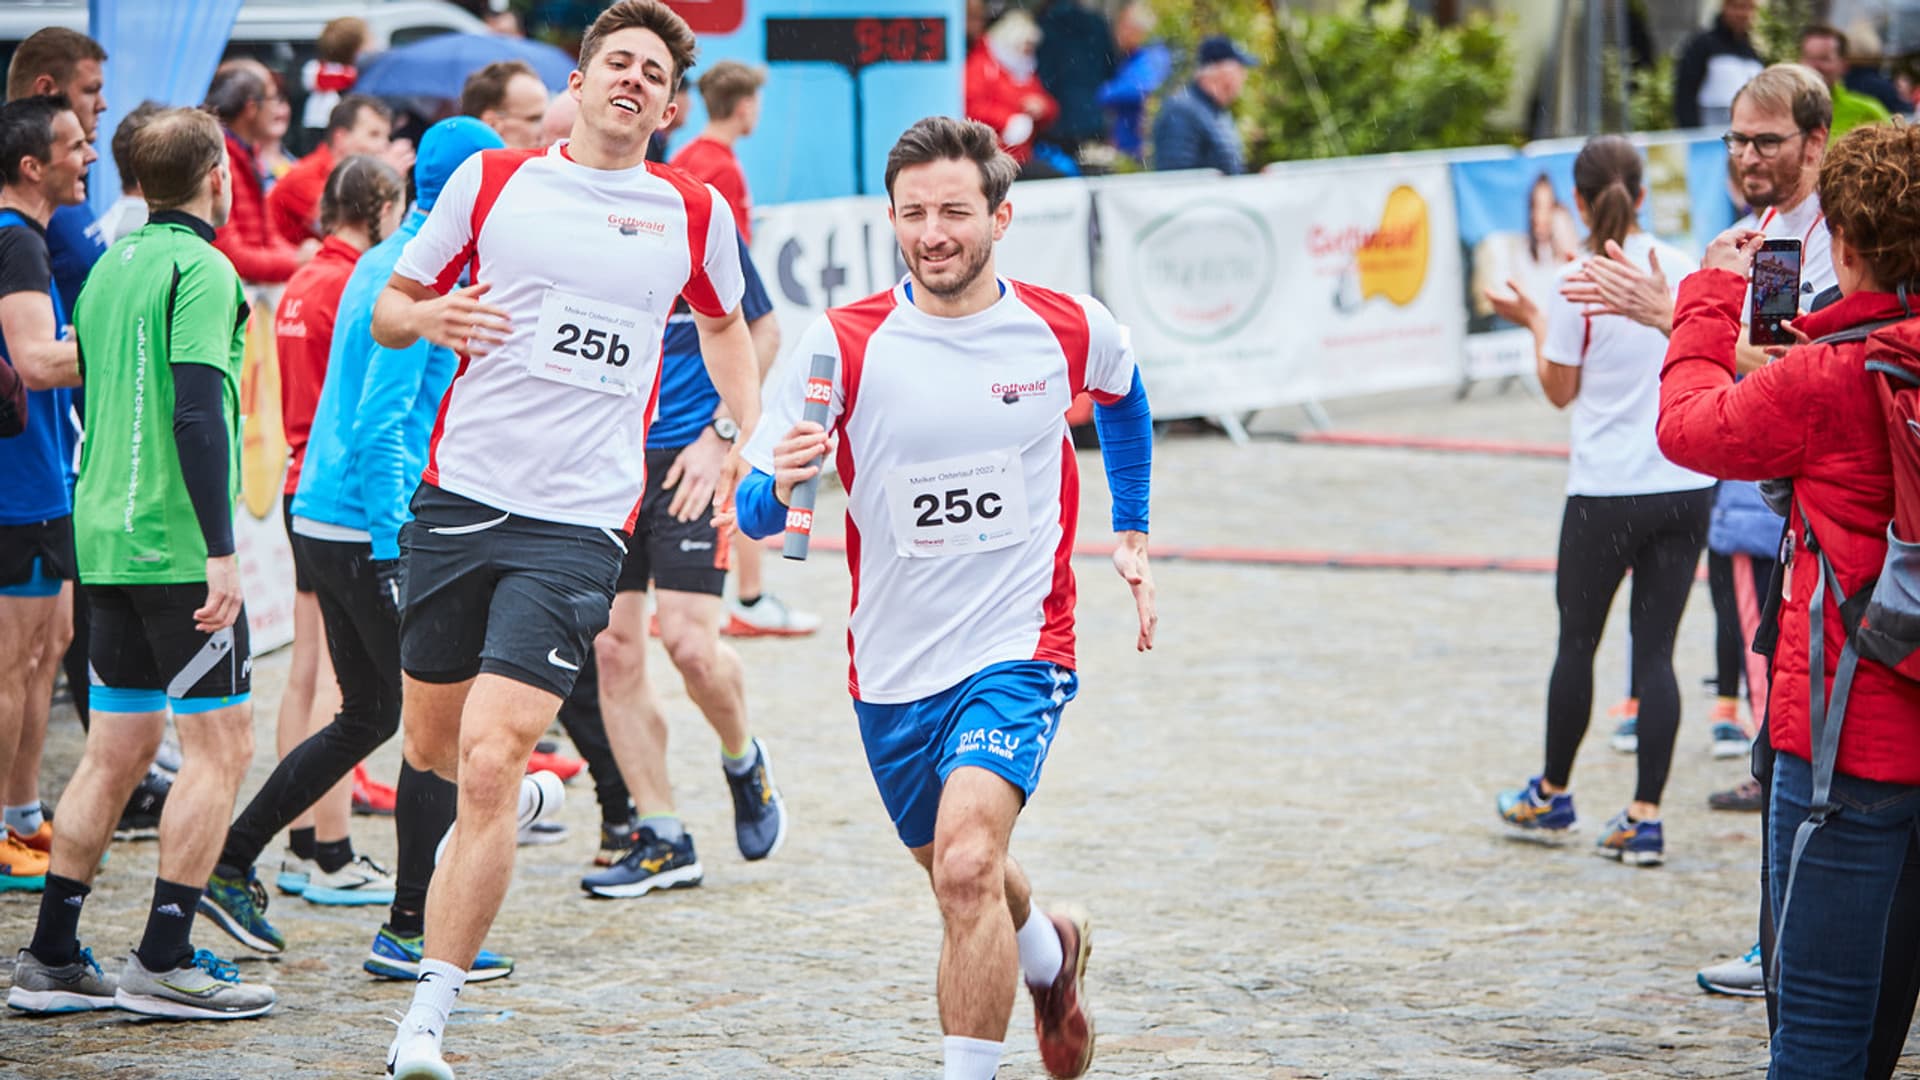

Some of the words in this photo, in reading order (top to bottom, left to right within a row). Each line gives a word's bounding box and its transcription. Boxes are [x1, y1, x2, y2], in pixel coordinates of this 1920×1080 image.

[607, 213, 666, 233] Gottwald
[552, 323, 630, 367] 25b
[991, 379, 1047, 394] Gottwald
[913, 488, 1003, 527] 25c
